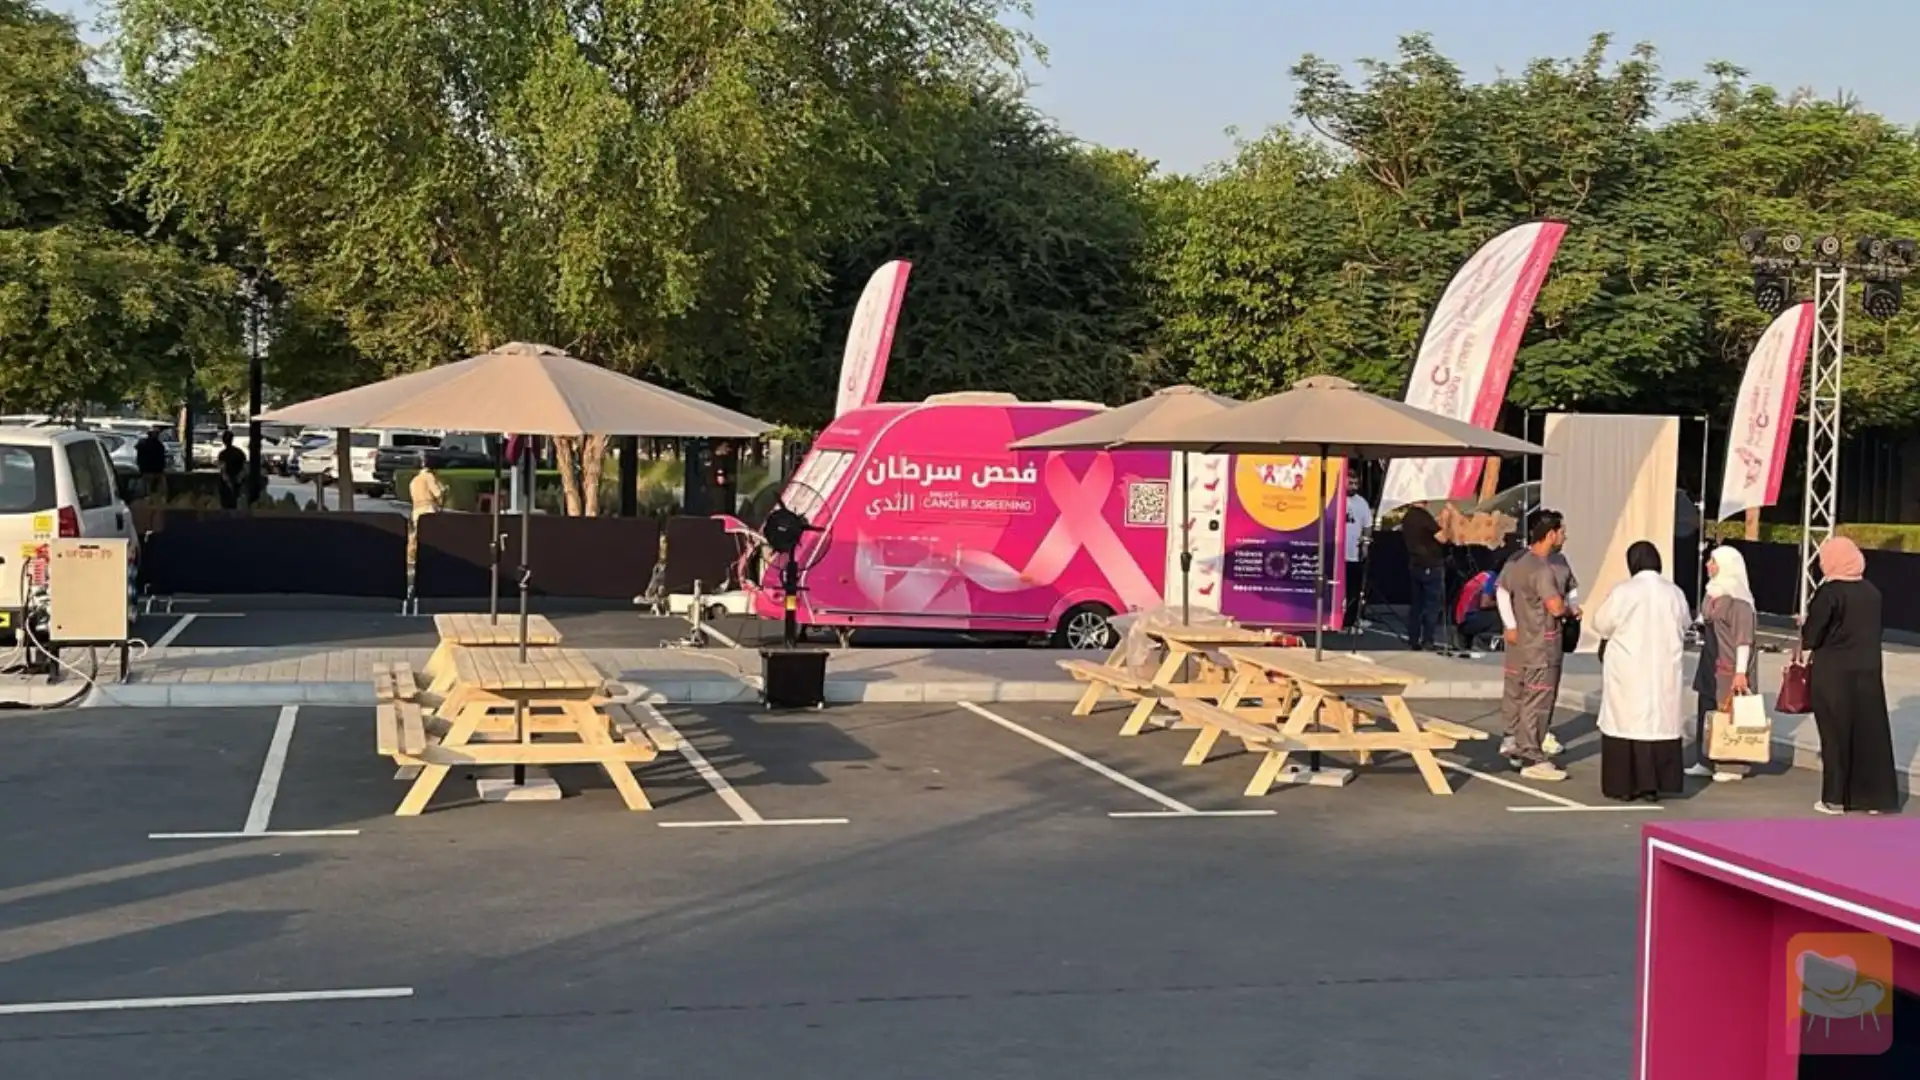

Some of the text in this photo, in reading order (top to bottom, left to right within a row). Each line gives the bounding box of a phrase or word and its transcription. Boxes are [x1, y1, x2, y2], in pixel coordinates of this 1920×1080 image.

[866, 455, 1037, 488] فحص سرطان
[866, 491, 914, 519] الثدي
[923, 498, 1033, 512] CANCER SCREENING
